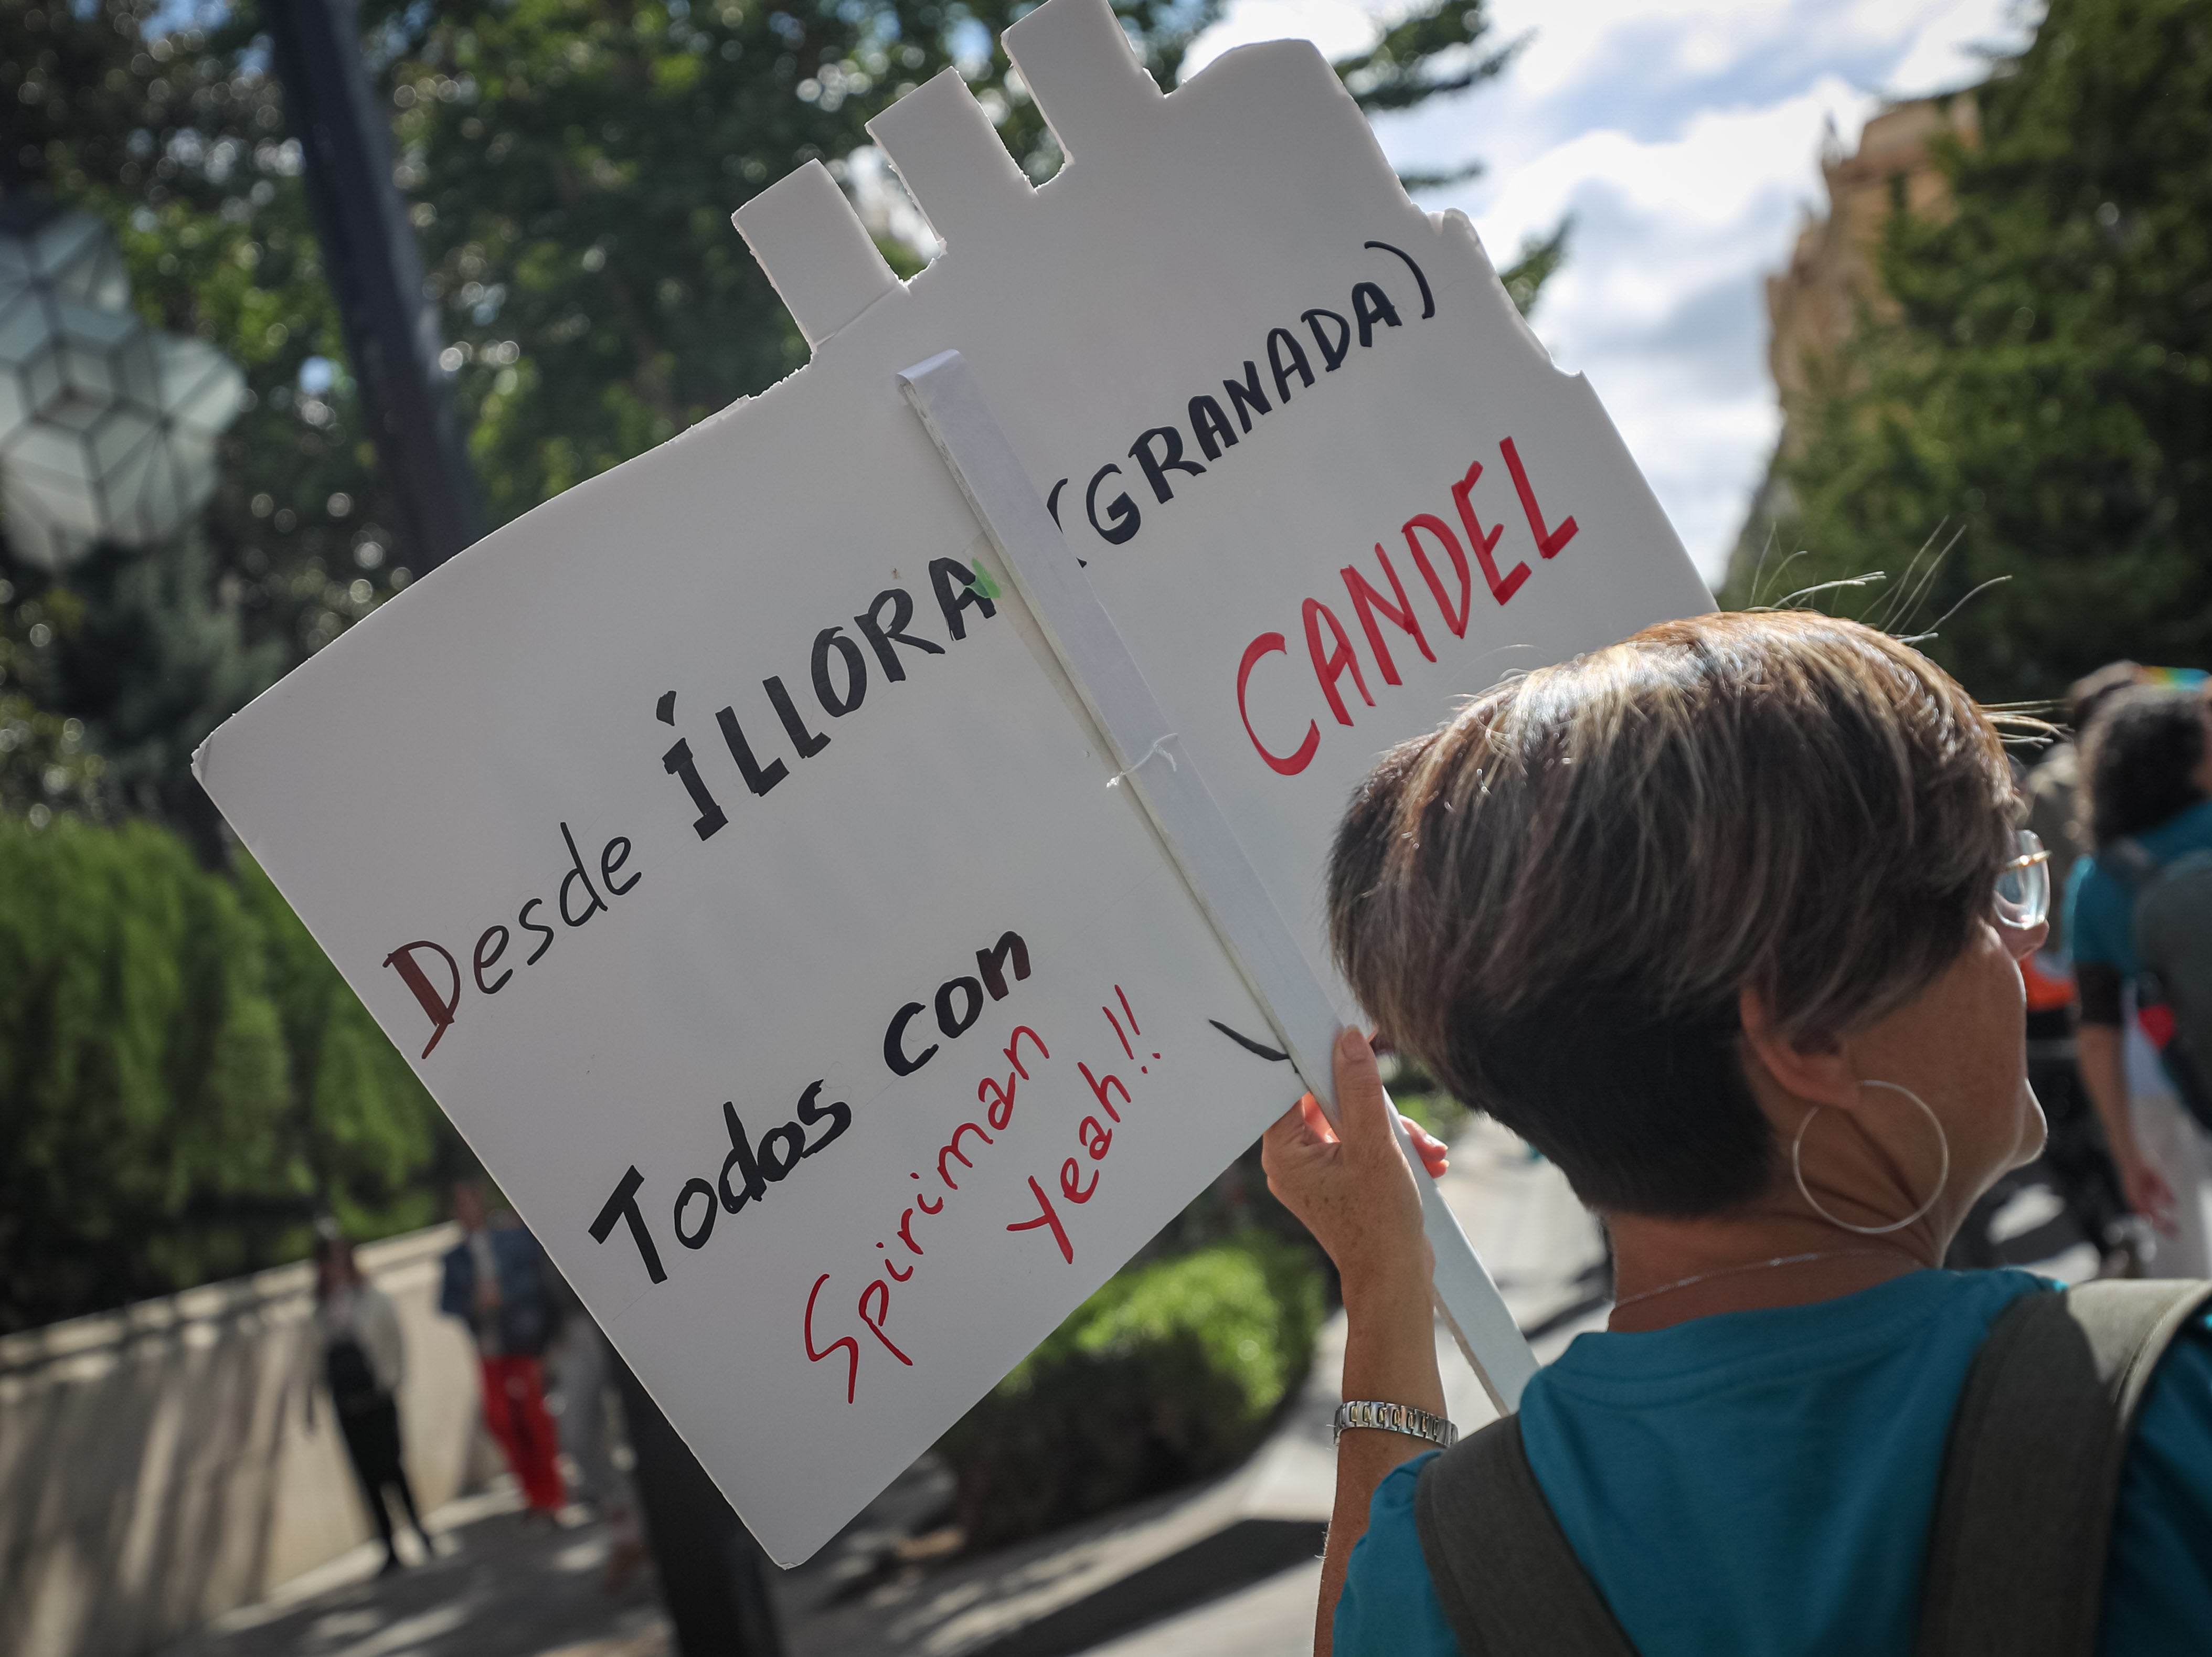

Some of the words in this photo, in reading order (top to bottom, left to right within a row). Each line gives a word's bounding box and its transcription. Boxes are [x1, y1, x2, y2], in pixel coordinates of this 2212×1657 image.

[382, 822, 642, 1059] Desde
[588, 1079, 852, 1284] Todos
[883, 930, 1031, 1077] con
[1237, 436, 1579, 776] CANDEL
[804, 1025, 1050, 1405] Spiriman
